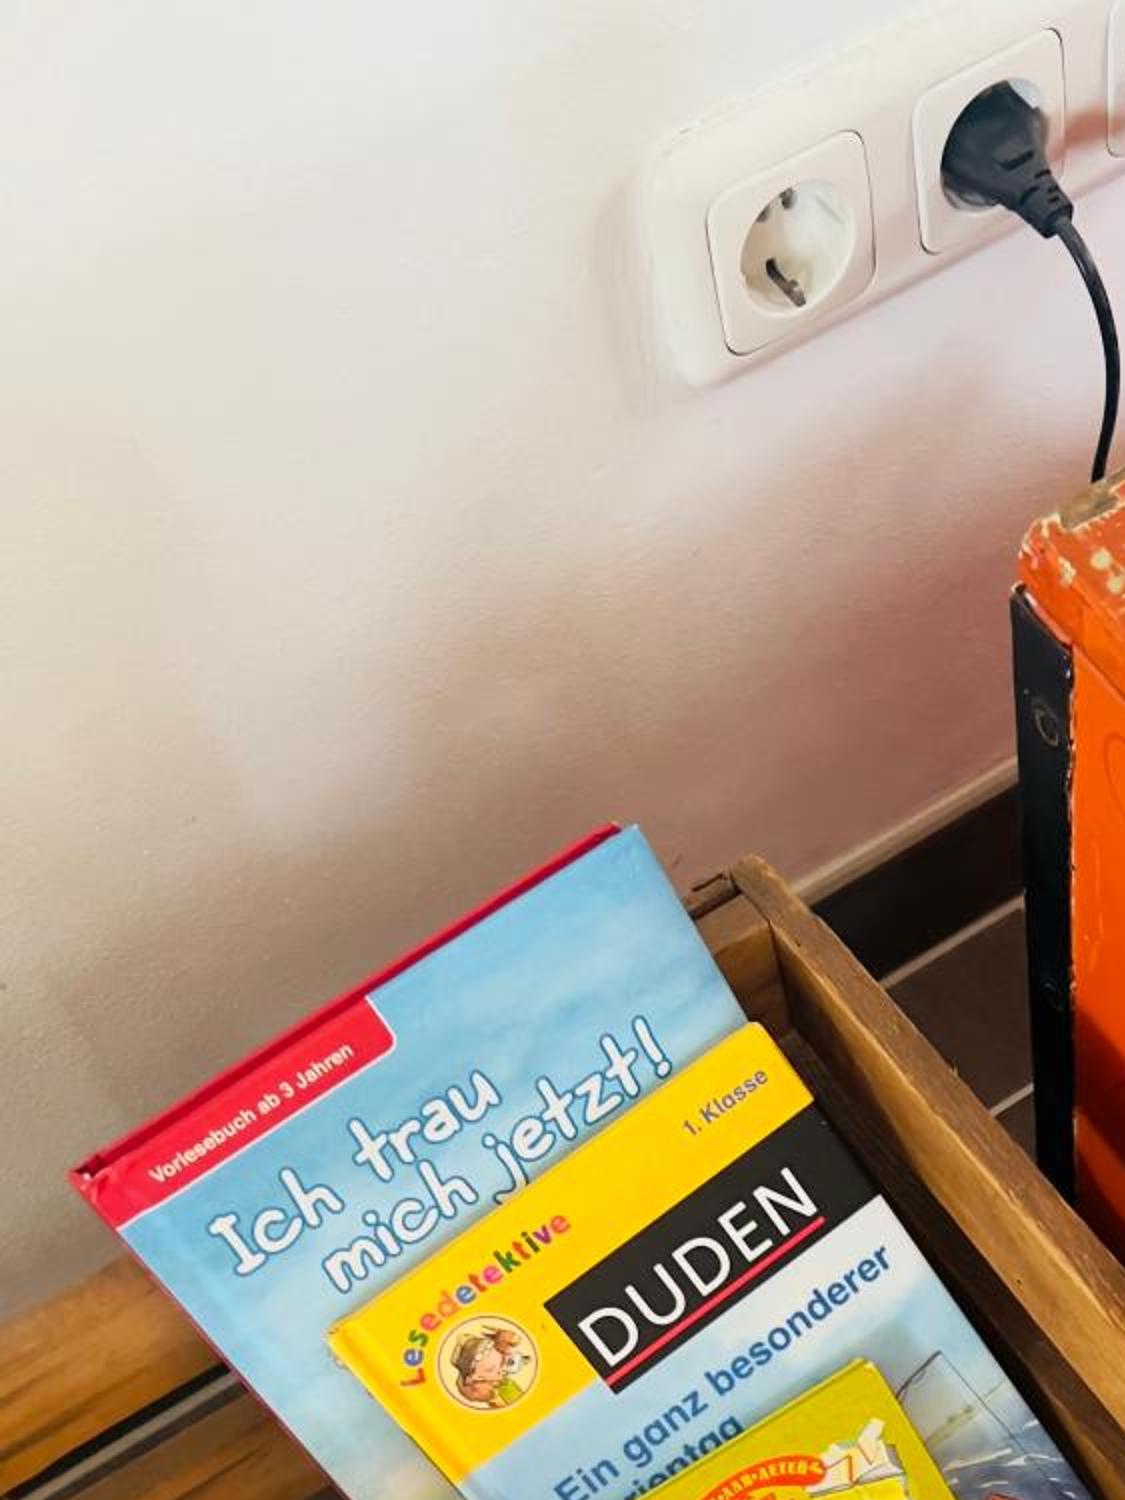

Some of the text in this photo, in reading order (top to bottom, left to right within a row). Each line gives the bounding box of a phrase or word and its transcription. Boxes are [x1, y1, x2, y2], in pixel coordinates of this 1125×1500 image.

[147, 1038, 356, 1190] Vorlesebuch ab 3 Jahren
[201, 1040, 505, 1281] Ich trau
[302, 1011, 675, 1297] mich jetzt!
[678, 1064, 771, 1140] 1. Klasse
[397, 1216, 569, 1383] Lesedetektive
[574, 1165, 823, 1370] DUDEN
[615, 1383, 717, 1472] ganz
[701, 1239, 899, 1399] besonderer
